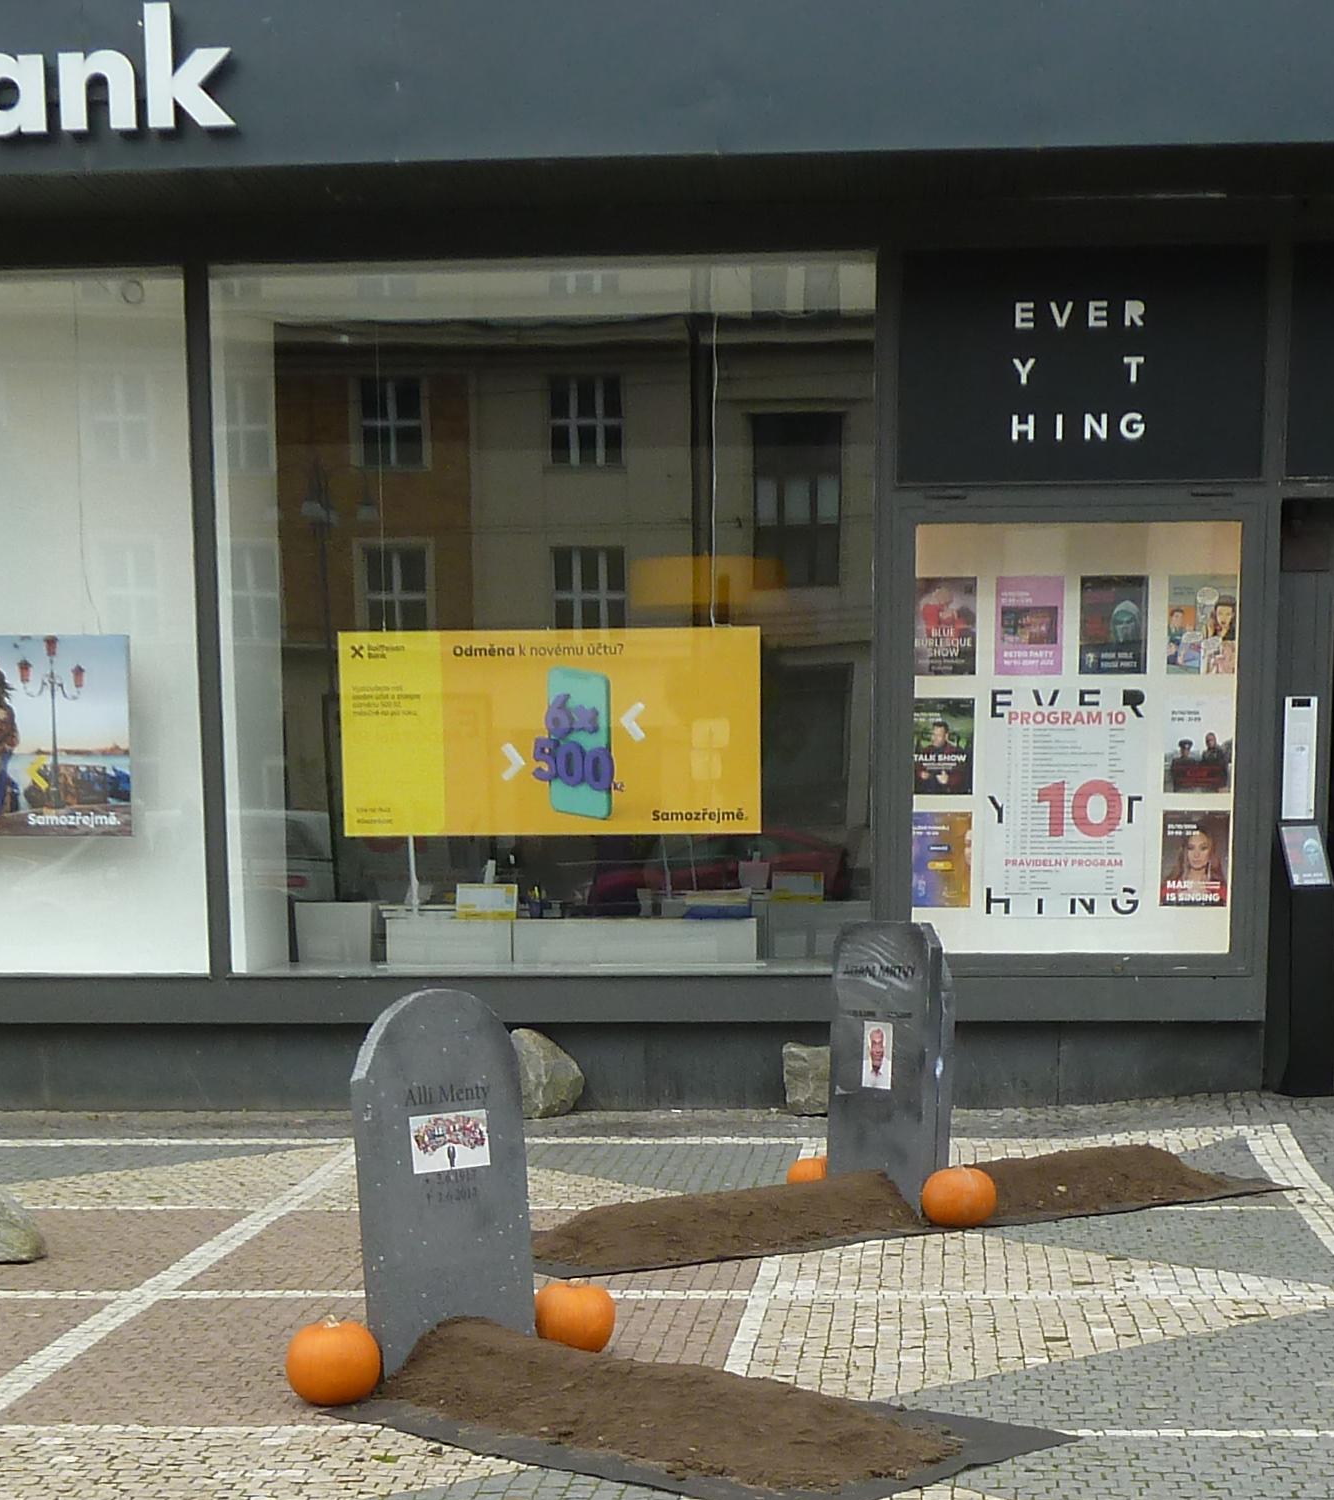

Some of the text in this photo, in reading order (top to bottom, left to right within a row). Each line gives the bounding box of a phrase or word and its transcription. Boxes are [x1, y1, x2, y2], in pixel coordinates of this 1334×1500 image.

[1015, 300, 1145, 329] EVER
[1012, 356, 1145, 385] Y T
[1011, 412, 1146, 442] HING
[931, 627, 955, 637] BLUE
[452, 643, 624, 657] Odměna k novému účtu?
[1007, 711, 1127, 726] PROGRAM 10
[532, 736, 615, 791] 500
[937, 754, 967, 762] SHOW
[1037, 779, 1123, 838] 10
[27, 811, 122, 828] Samozřejmě.
[1004, 858, 1123, 868] PRAVIDELNÝ PROGRAM
[405, 1083, 490, 1107] Alli Menty
